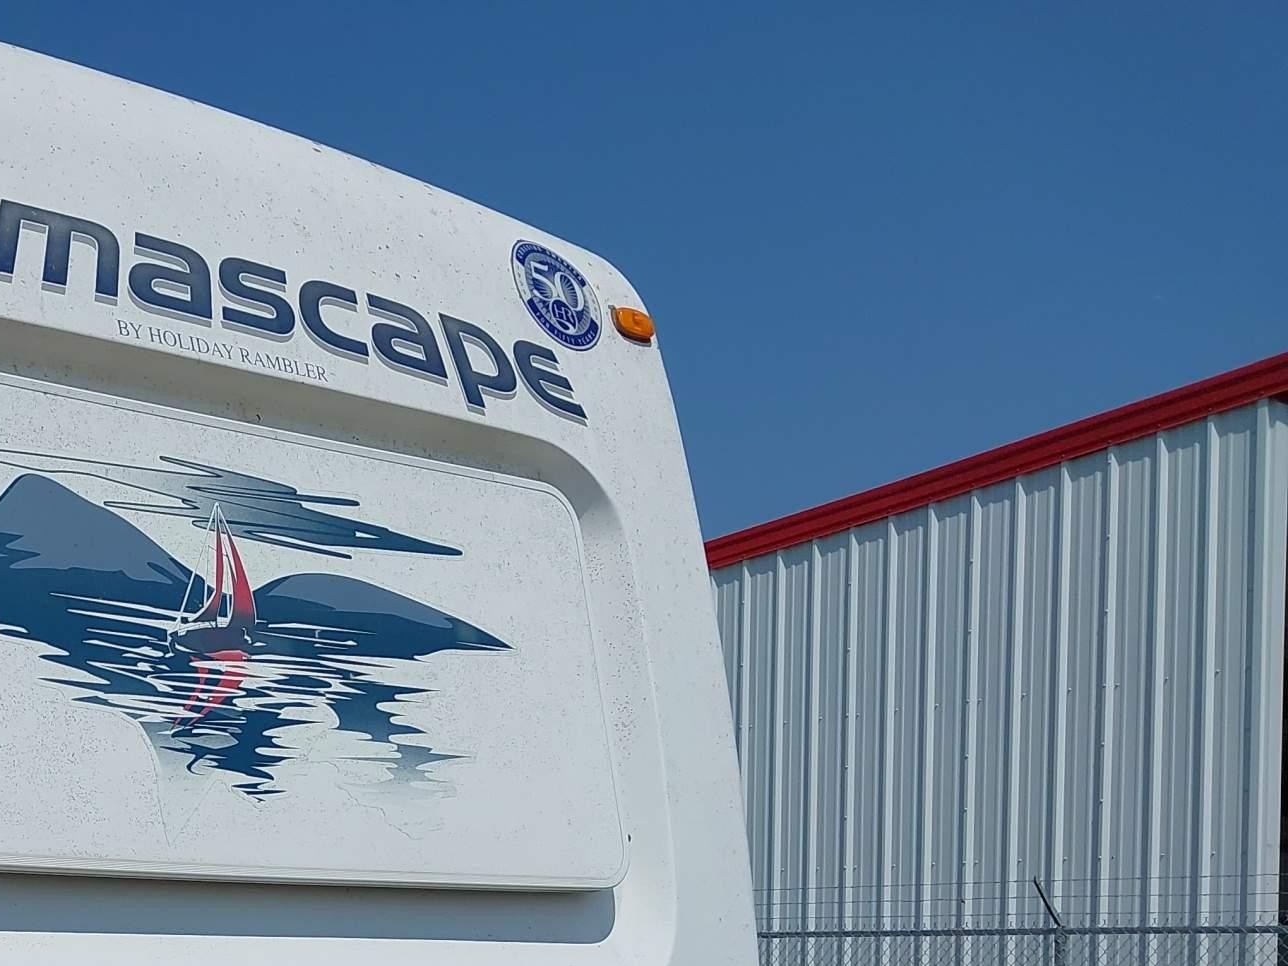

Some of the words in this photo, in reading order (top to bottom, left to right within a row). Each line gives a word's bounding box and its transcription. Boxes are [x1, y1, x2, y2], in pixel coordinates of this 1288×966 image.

[530, 261, 585, 312] 50
[117, 319, 144, 340] BY
[147, 326, 235, 360] HOLIDAY
[239, 347, 329, 383] RAMBLER
